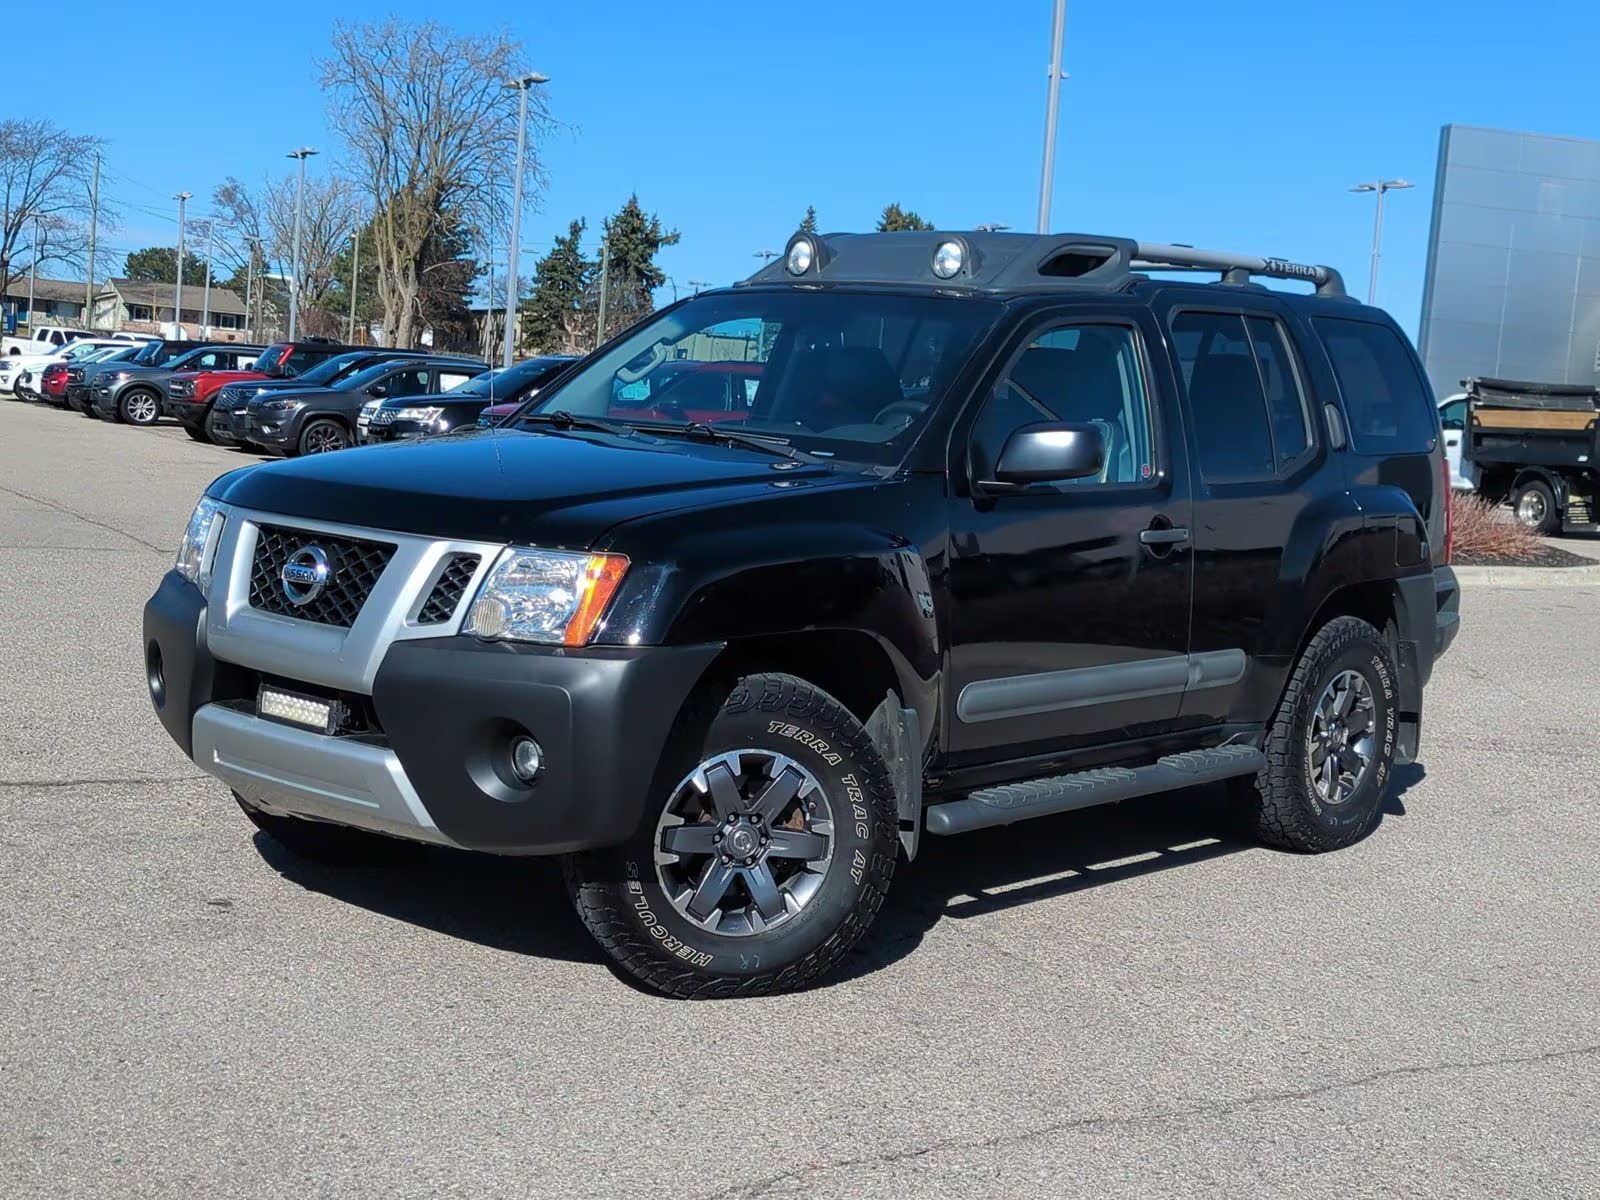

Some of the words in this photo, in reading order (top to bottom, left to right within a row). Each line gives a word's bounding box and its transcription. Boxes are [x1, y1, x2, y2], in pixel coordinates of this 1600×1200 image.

[1262, 258, 1317, 277] XTERRA
[283, 565, 319, 581] NISSAN
[768, 720, 843, 766] TERRA
[841, 773, 869, 840] TRAC
[850, 848, 867, 886] AT
[626, 861, 714, 967] HERCULES
